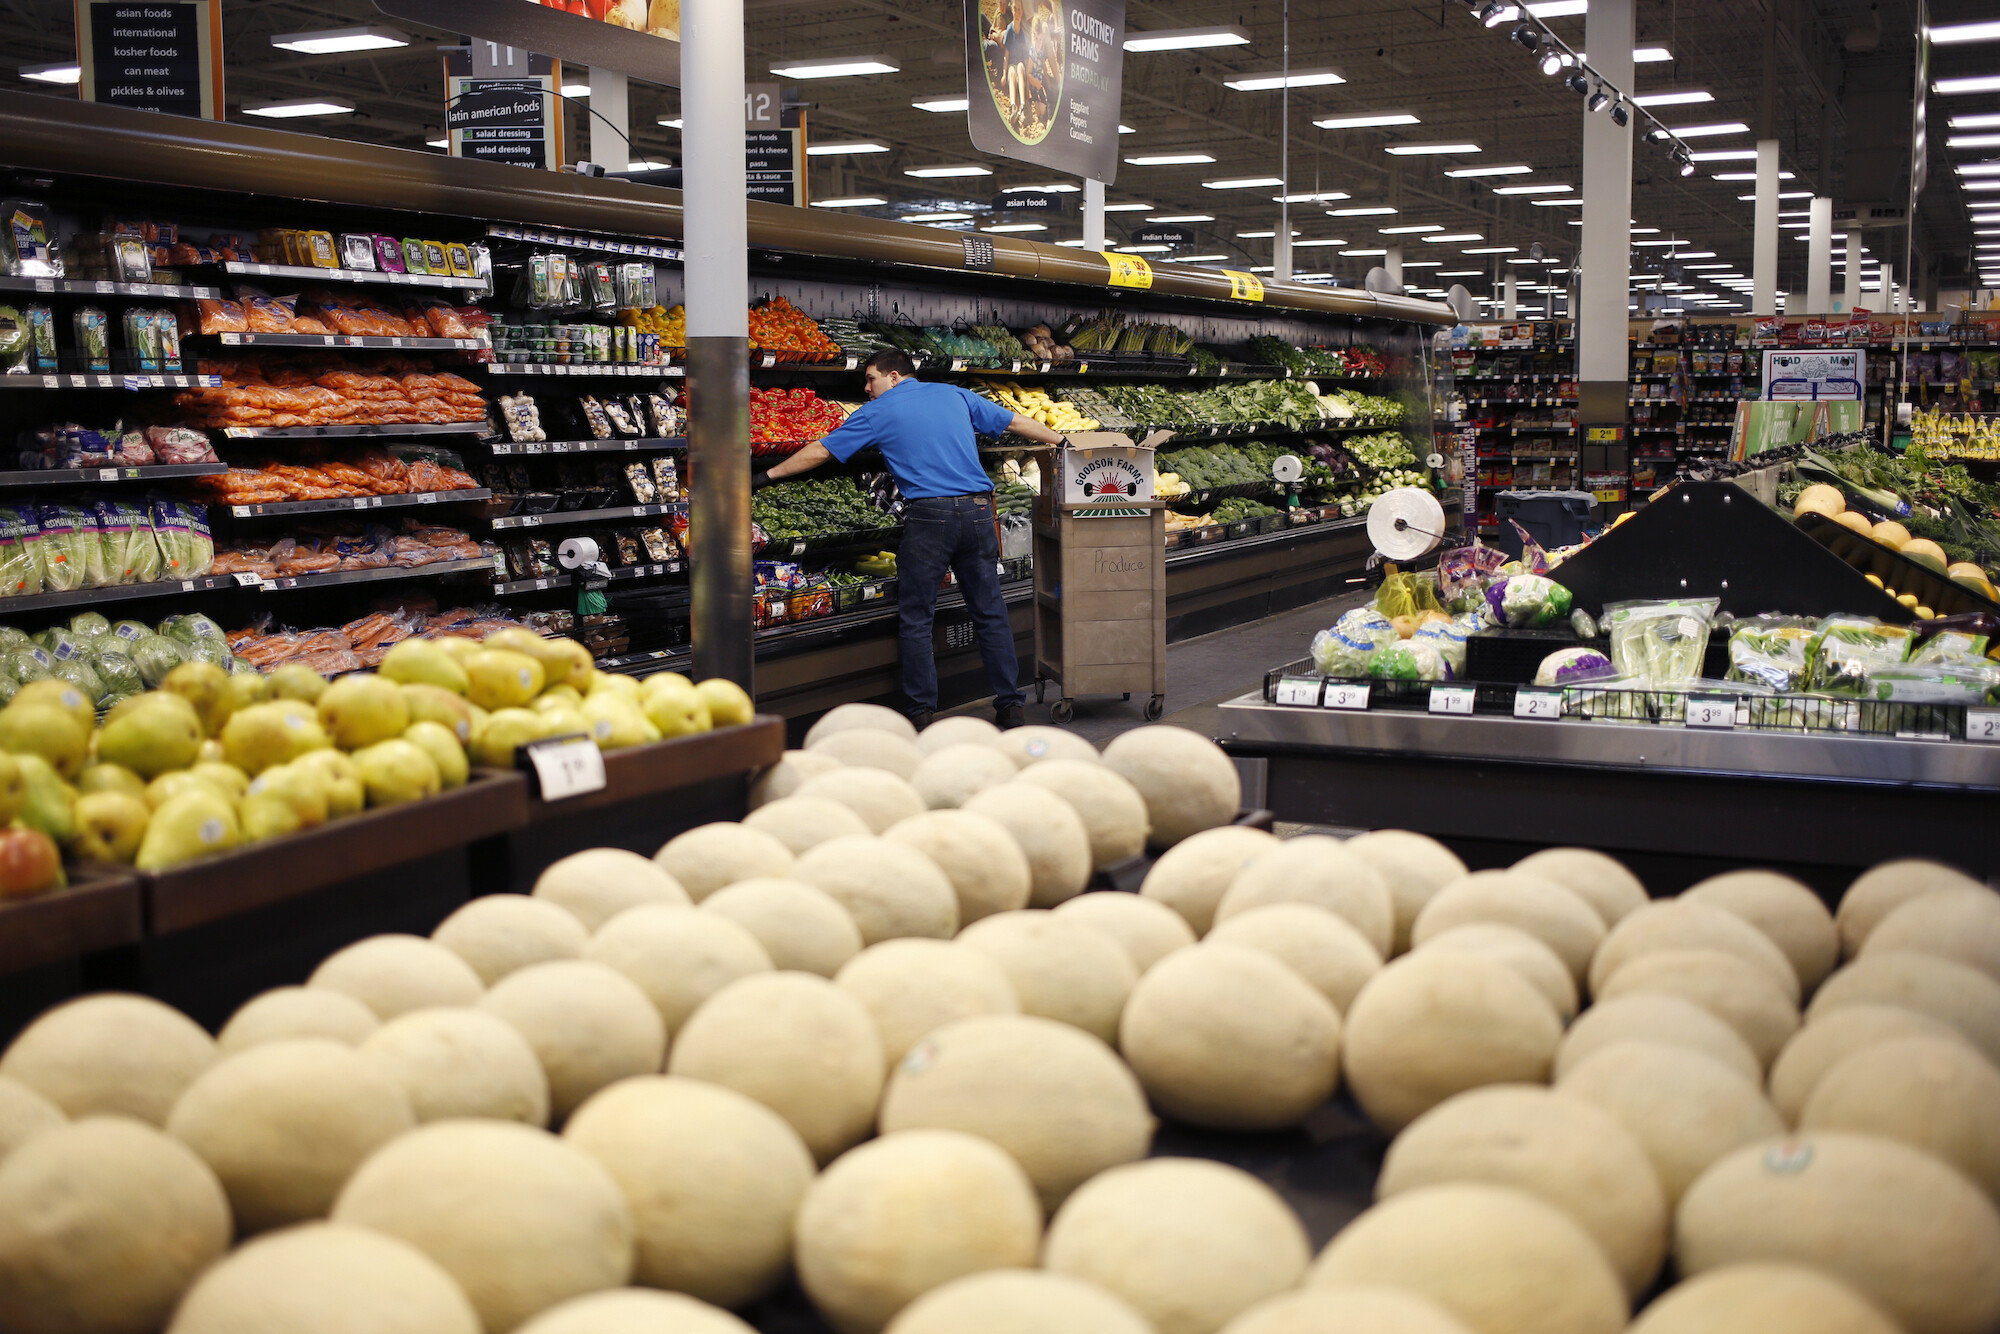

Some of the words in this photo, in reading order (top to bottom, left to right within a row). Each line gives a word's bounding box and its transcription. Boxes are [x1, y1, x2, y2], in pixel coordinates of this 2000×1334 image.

[115, 8, 141, 18] asian
[144, 8, 172, 18] foods
[113, 27, 177, 38] international
[1071, 9, 1115, 46] COURTNEY
[113, 46, 147, 57] kosher
[149, 46, 178, 57] foods
[486, 40, 513, 67] 11
[1071, 33, 1099, 63] FARMS
[124, 67, 141, 76] can
[143, 66, 169, 76] meat
[1070, 62, 1099, 91] BAGDAD,
[110, 86, 144, 97] pickles
[146, 86, 154, 96] &
[156, 85, 185, 96] olives
[448, 110, 469, 122] latin
[470, 104, 512, 120] american
[513, 99, 541, 113] foods
[745, 93, 771, 121] 12
[1070, 98, 1090, 116] Eggplant
[1069, 112, 1087, 129] Peppers
[475, 129, 497, 138] salad
[498, 129, 532, 140] dressing
[759, 133, 778, 141] foods
[1069, 126, 1093, 145] Cucumbers
[475, 145, 497, 154] salad
[498, 145, 532, 156] dressing
[766, 146, 788, 154] cheese
[749, 160, 768, 168] pasta
[763, 172, 781, 180] sauce
[1006, 199, 1025, 207] asian
[1026, 198, 1047, 207] foods
[1142, 233, 1162, 241] indian
[1163, 233, 1182, 241] foods
[1075, 457, 1113, 486] GOODSON
[1117, 459, 1144, 485] FARMS
[1095, 549, 1146, 574] Produce
